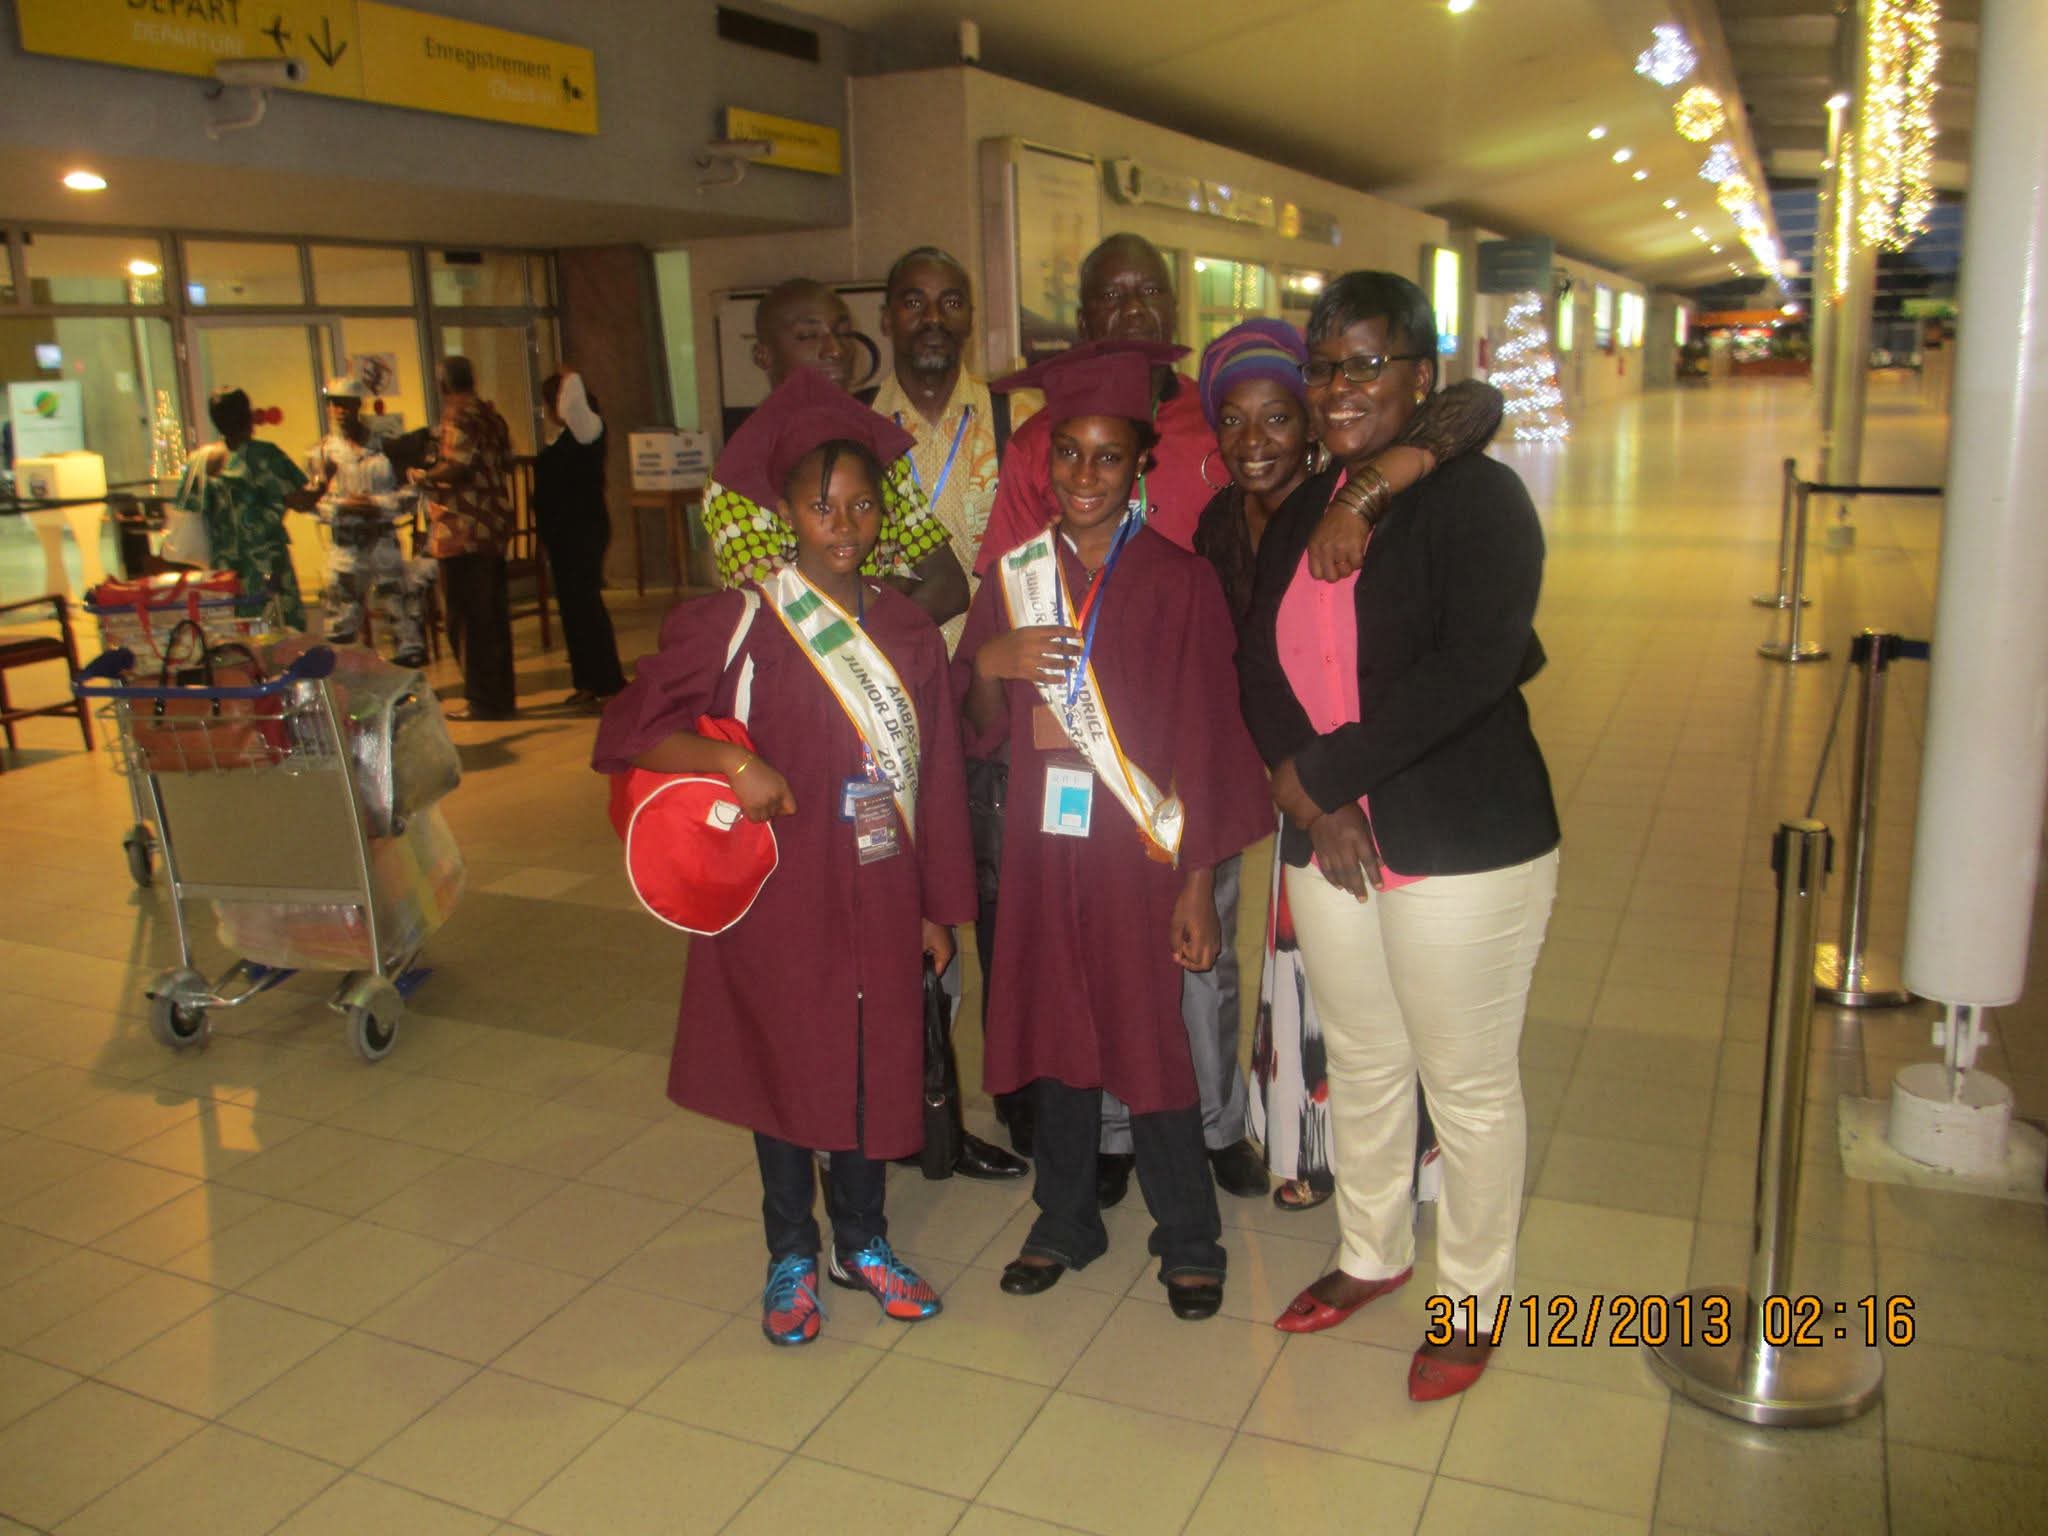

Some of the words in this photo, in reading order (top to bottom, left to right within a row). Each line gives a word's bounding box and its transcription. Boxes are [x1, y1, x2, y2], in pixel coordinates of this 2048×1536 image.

[423, 35, 552, 81] Enregistrement
[1025, 570, 1049, 624] JUNIOR
[841, 655, 889, 714] JUNIOR
[884, 719, 903, 742] DE
[877, 749, 906, 793] 2013
